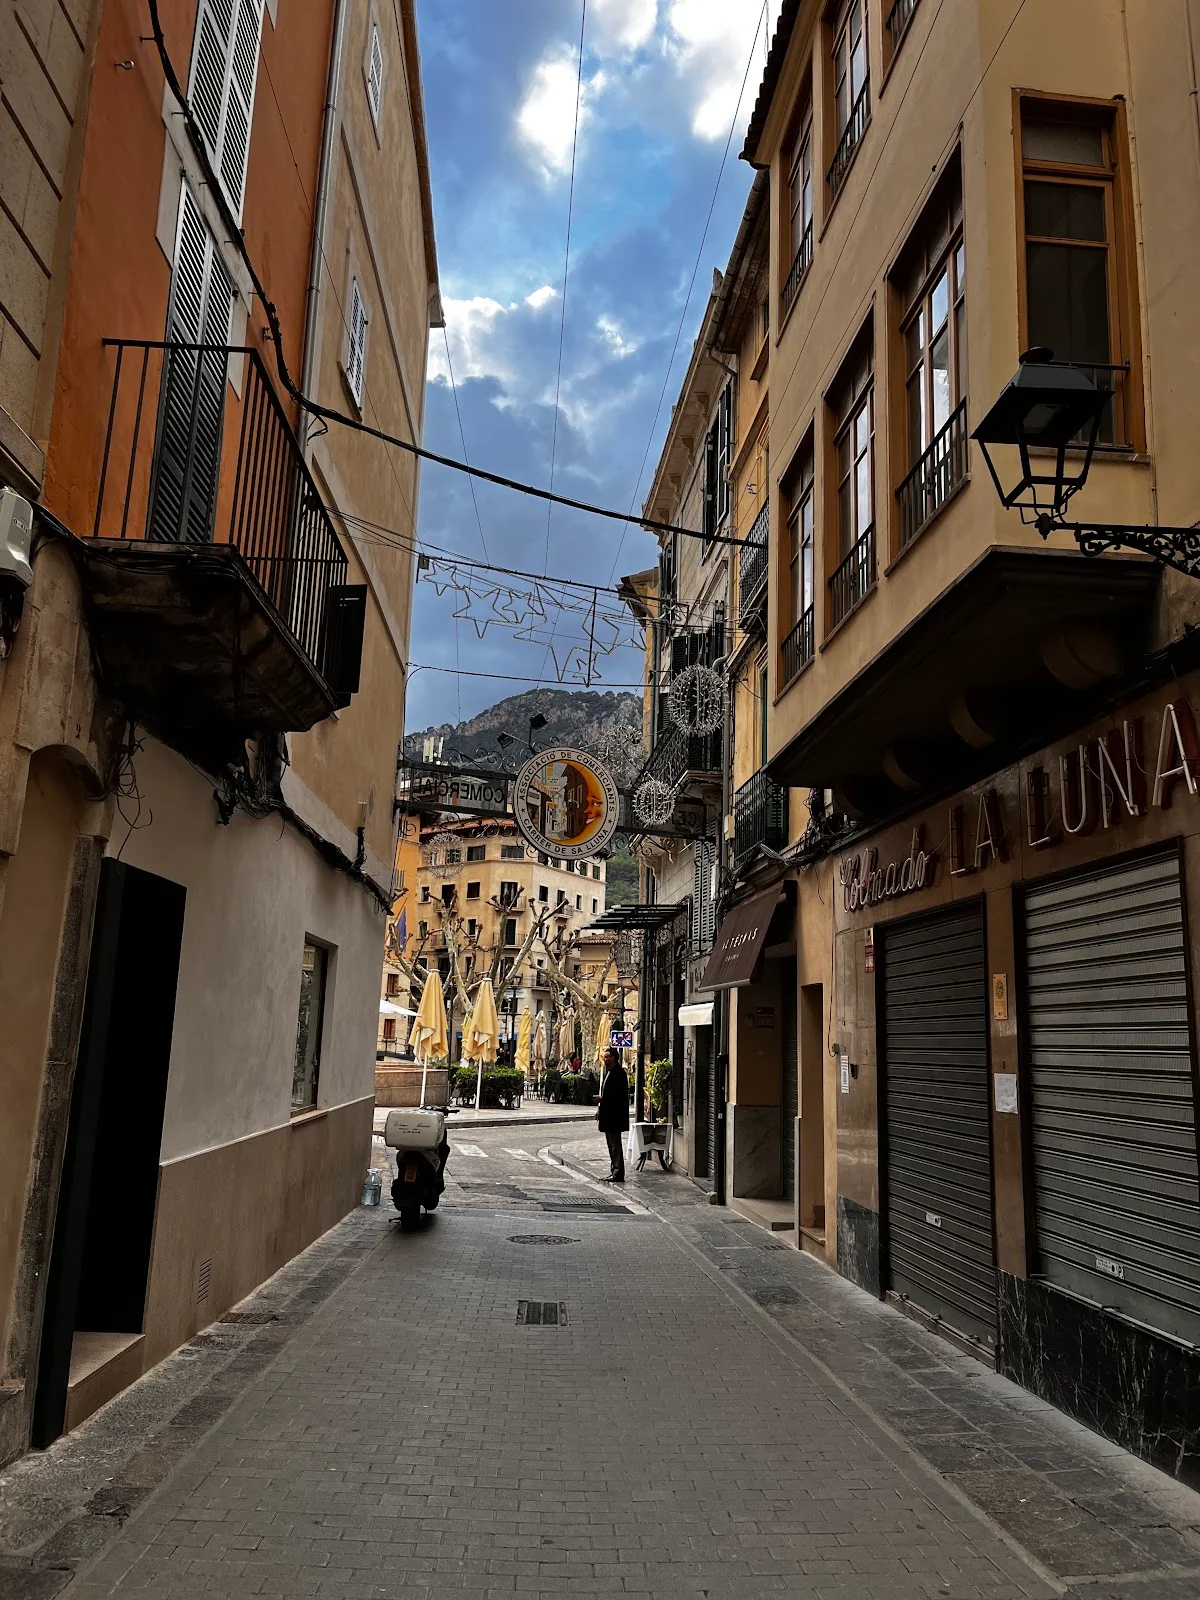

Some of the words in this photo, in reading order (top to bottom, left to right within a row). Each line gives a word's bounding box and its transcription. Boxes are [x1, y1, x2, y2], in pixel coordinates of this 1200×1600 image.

[75, 723, 82, 740] 2
[519, 751, 556, 801] ASSOCIACIÓ
[560, 751, 572, 759] DE
[576, 754, 615, 812] COMERCIANTS
[949, 789, 1005, 876] LA
[1026, 701, 1199, 848] LUNA
[523, 818, 552, 849] CARRER
[554, 844, 567, 854] DE
[571, 847, 582, 855] SA
[586, 829, 609, 850] LLUNA
